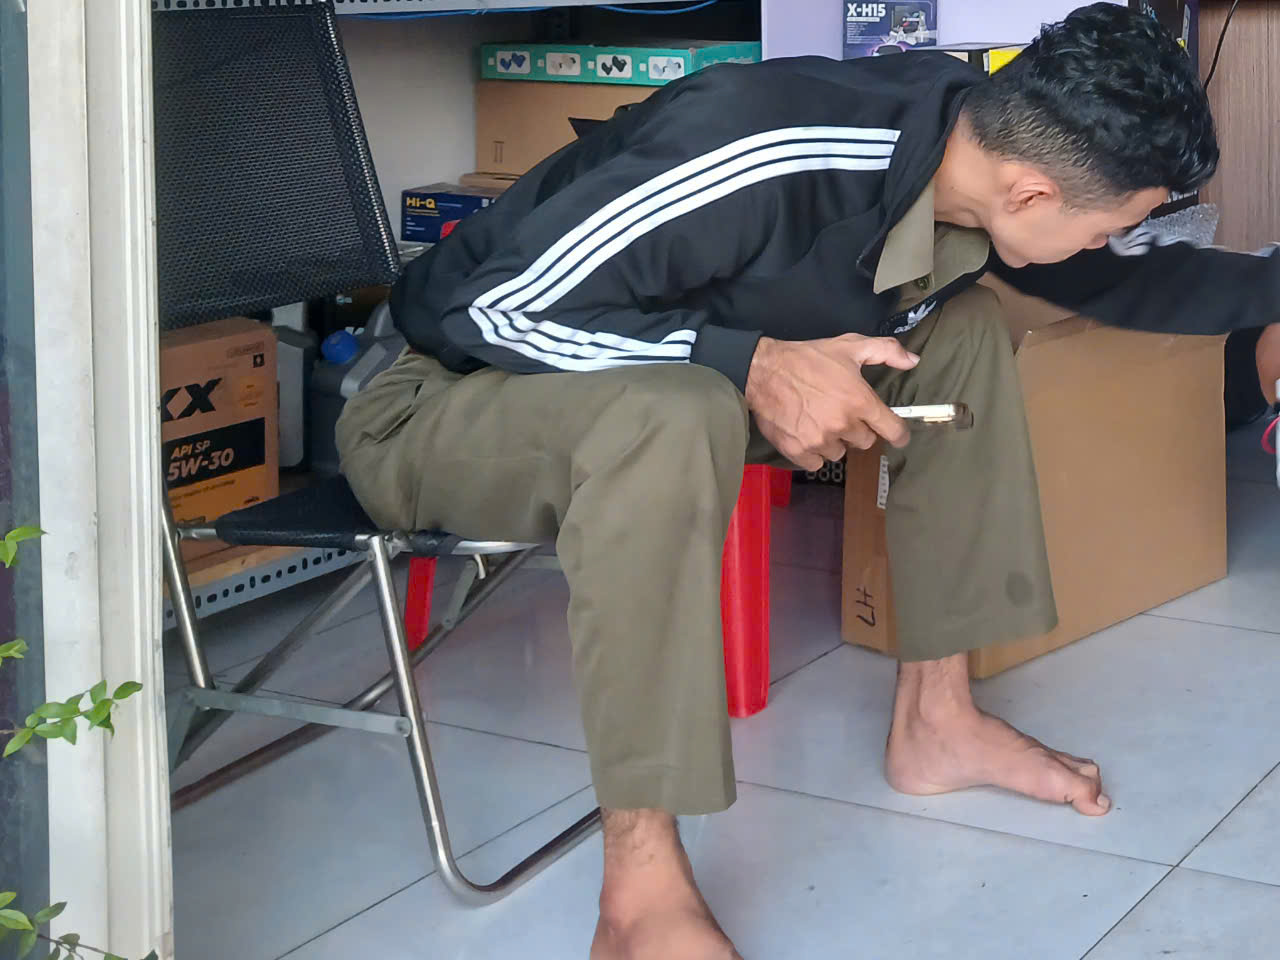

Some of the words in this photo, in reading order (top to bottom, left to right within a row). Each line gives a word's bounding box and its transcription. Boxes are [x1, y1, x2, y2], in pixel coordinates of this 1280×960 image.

[847, 2, 886, 18] X-H15
[170, 445, 193, 460] API
[194, 440, 211, 454] SP
[167, 448, 235, 481] 5W-30
